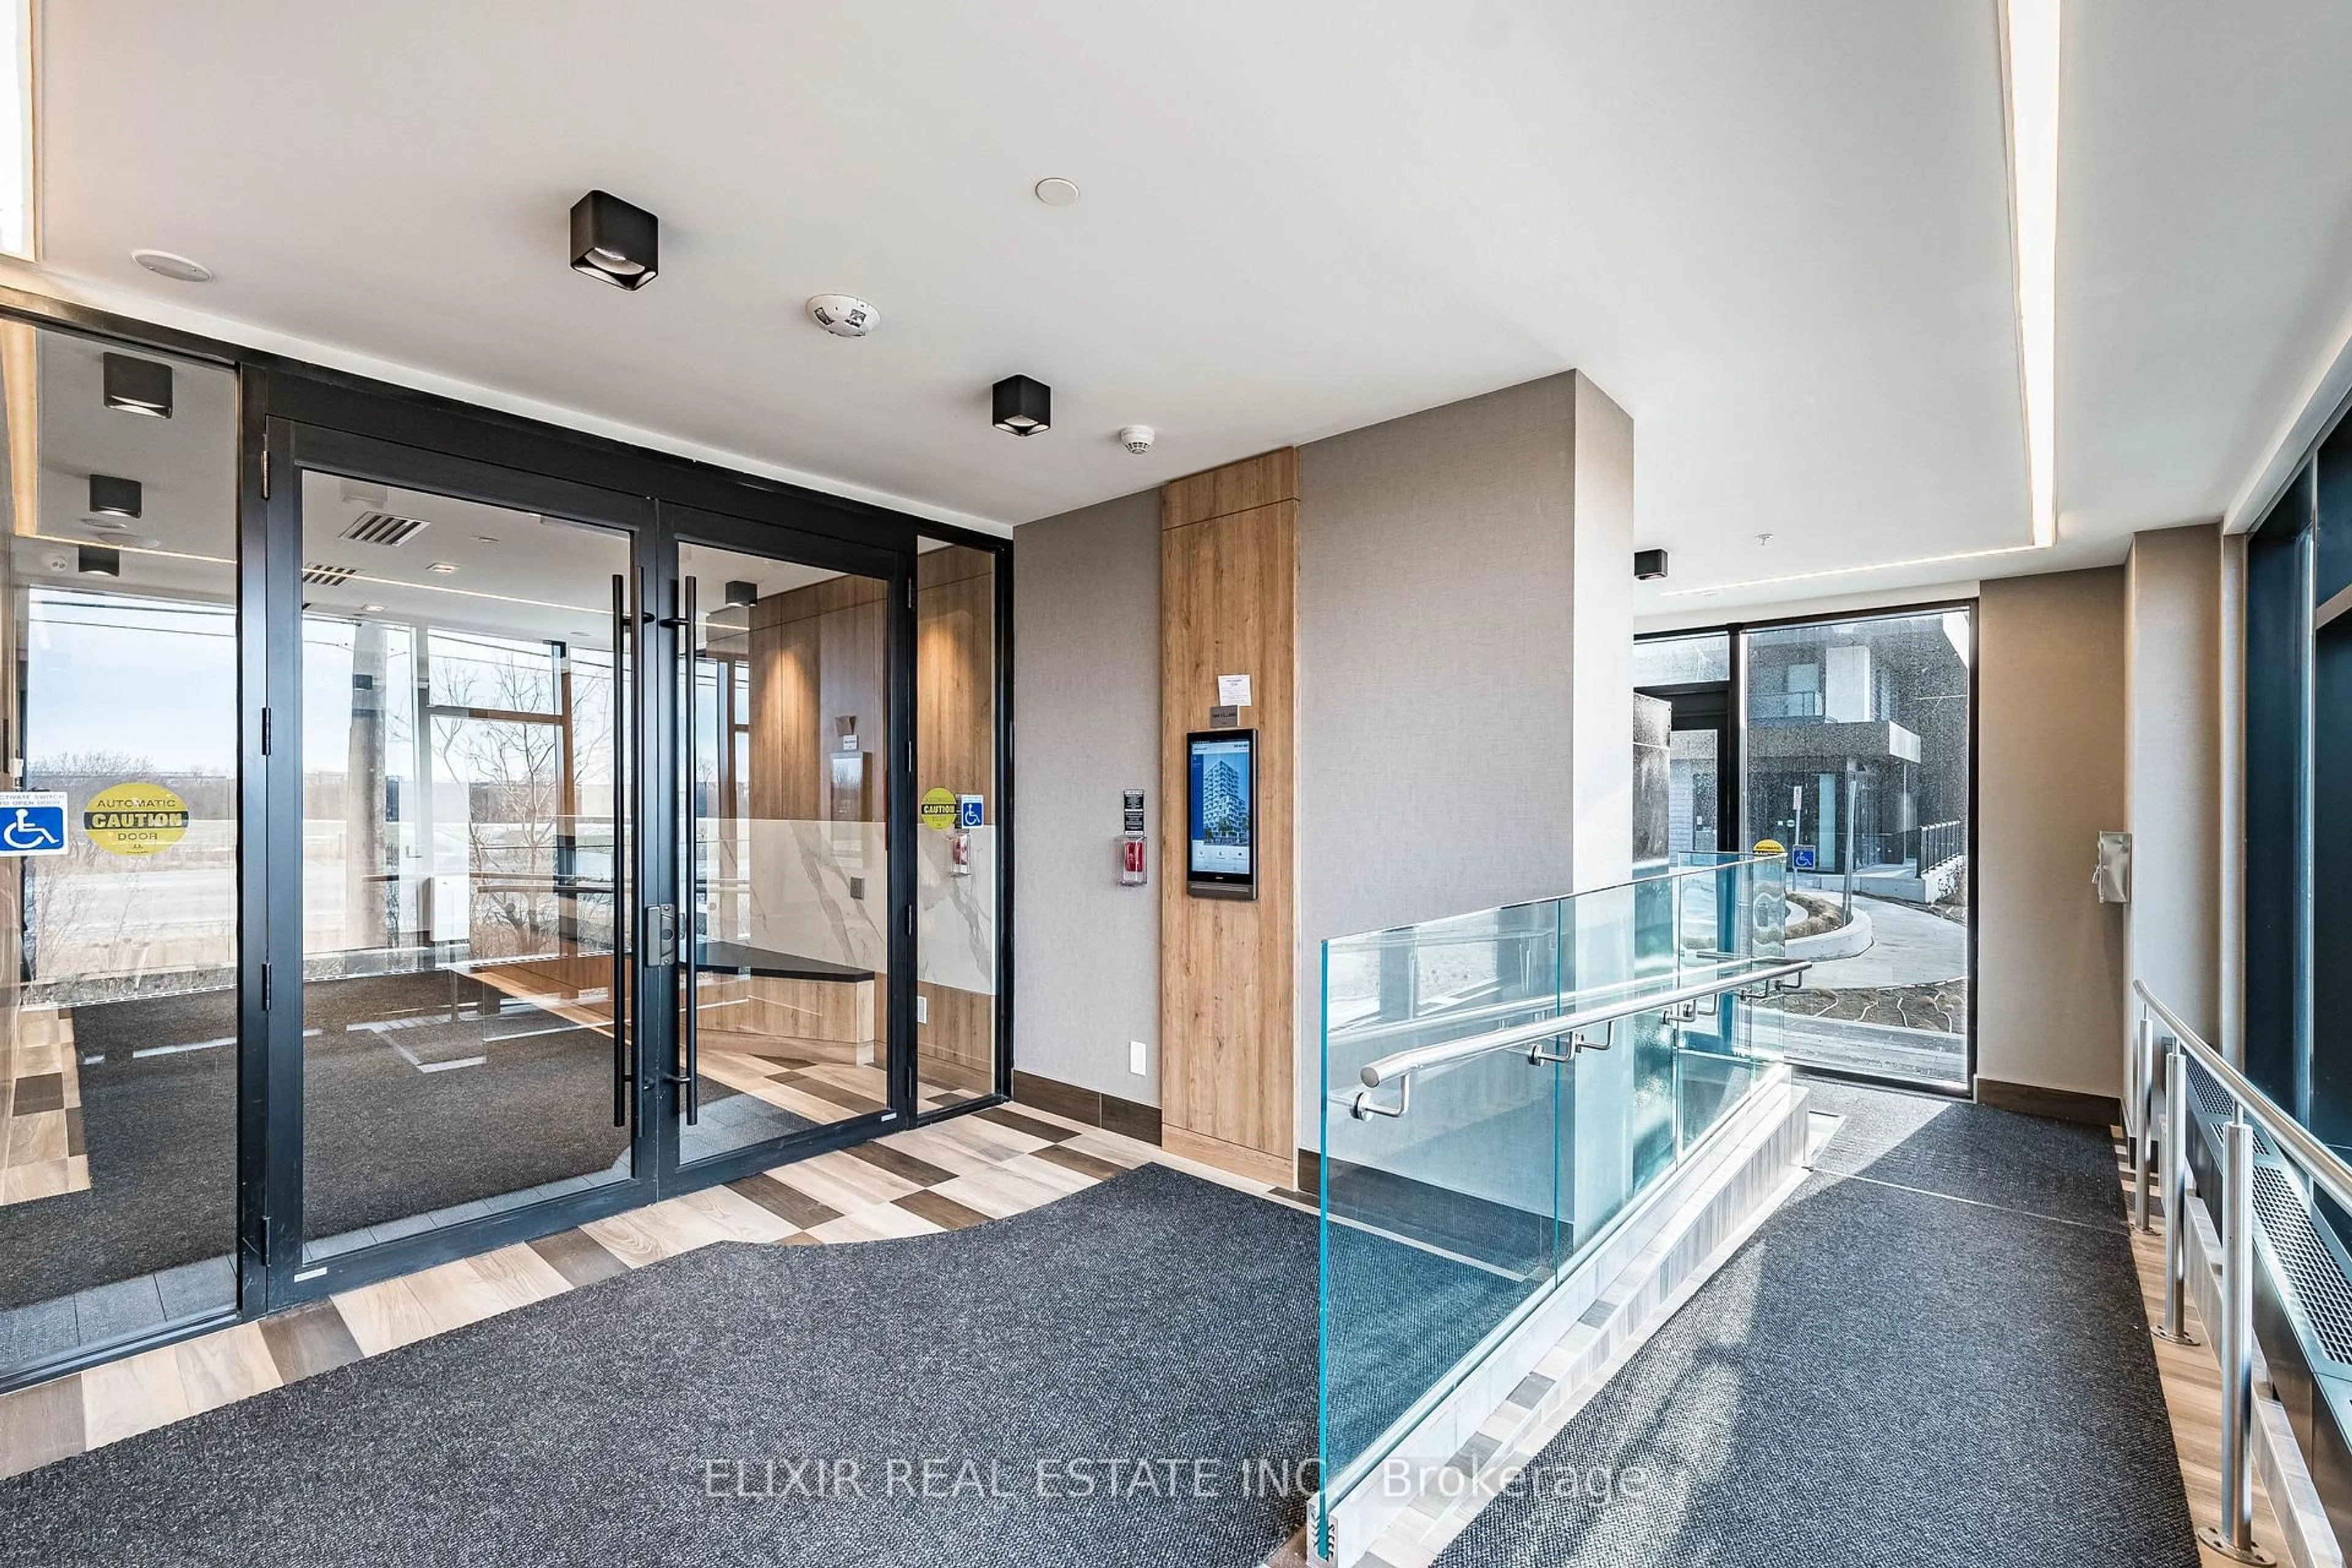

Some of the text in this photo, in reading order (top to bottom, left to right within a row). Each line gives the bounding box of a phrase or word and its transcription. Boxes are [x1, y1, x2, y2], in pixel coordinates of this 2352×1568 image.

[97, 799, 176, 808] AUTOMATIC
[92, 813, 183, 828] CAUTION
[117, 832, 158, 841] DOOR
